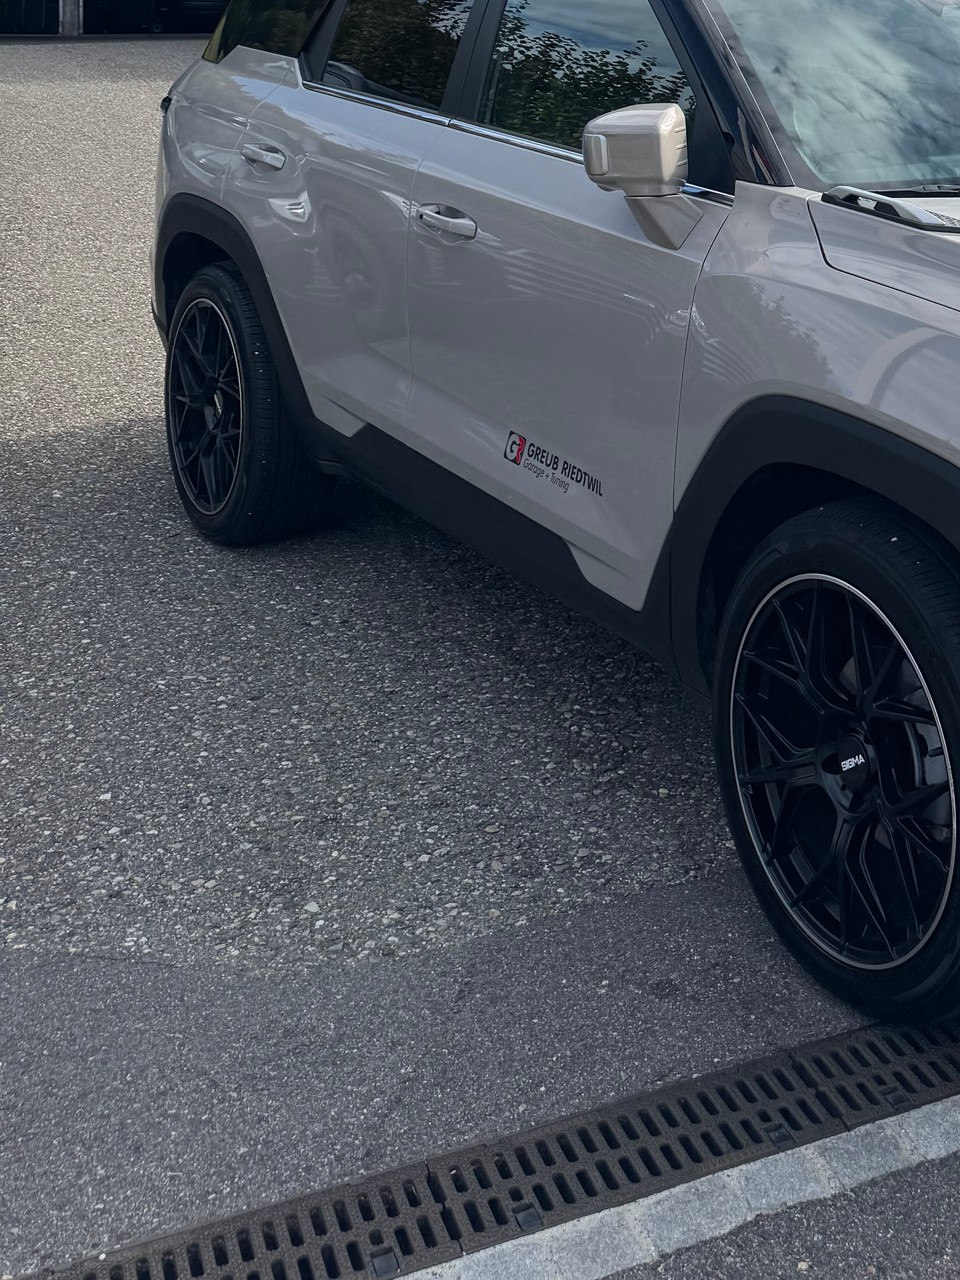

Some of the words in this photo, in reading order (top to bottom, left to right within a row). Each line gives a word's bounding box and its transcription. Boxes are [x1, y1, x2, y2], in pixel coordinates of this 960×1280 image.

[523, 458, 545, 478] Garage
[550, 472, 570, 494] Tuning
[527, 442, 560, 471] GREUB
[560, 460, 603, 497] RIEDTWIL
